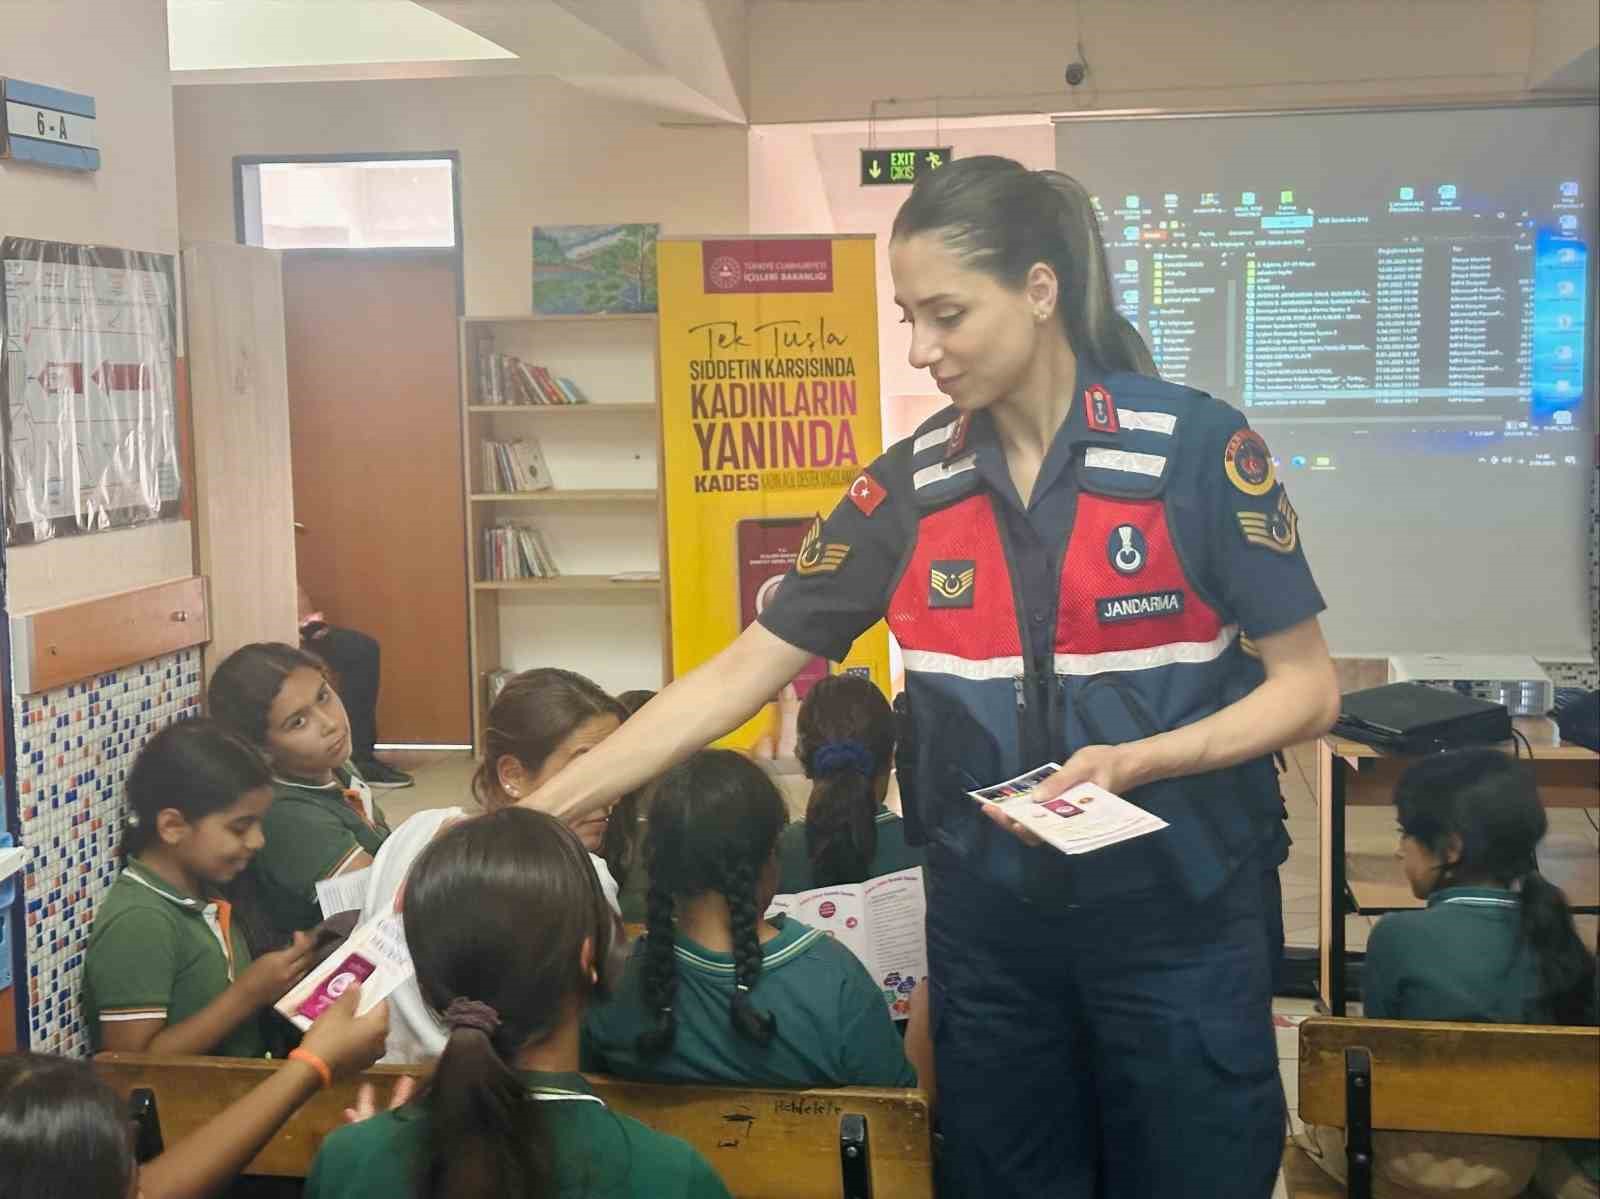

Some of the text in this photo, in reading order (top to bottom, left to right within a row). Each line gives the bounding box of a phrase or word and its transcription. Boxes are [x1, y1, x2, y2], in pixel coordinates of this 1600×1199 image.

[890, 152, 915, 166] EXIT
[688, 320, 752, 358] Tek
[689, 380, 858, 419] KADINLARIN
[693, 418, 859, 471] YANINDA
[694, 473, 760, 493] KADES
[1104, 594, 1179, 617] JANDARMA
